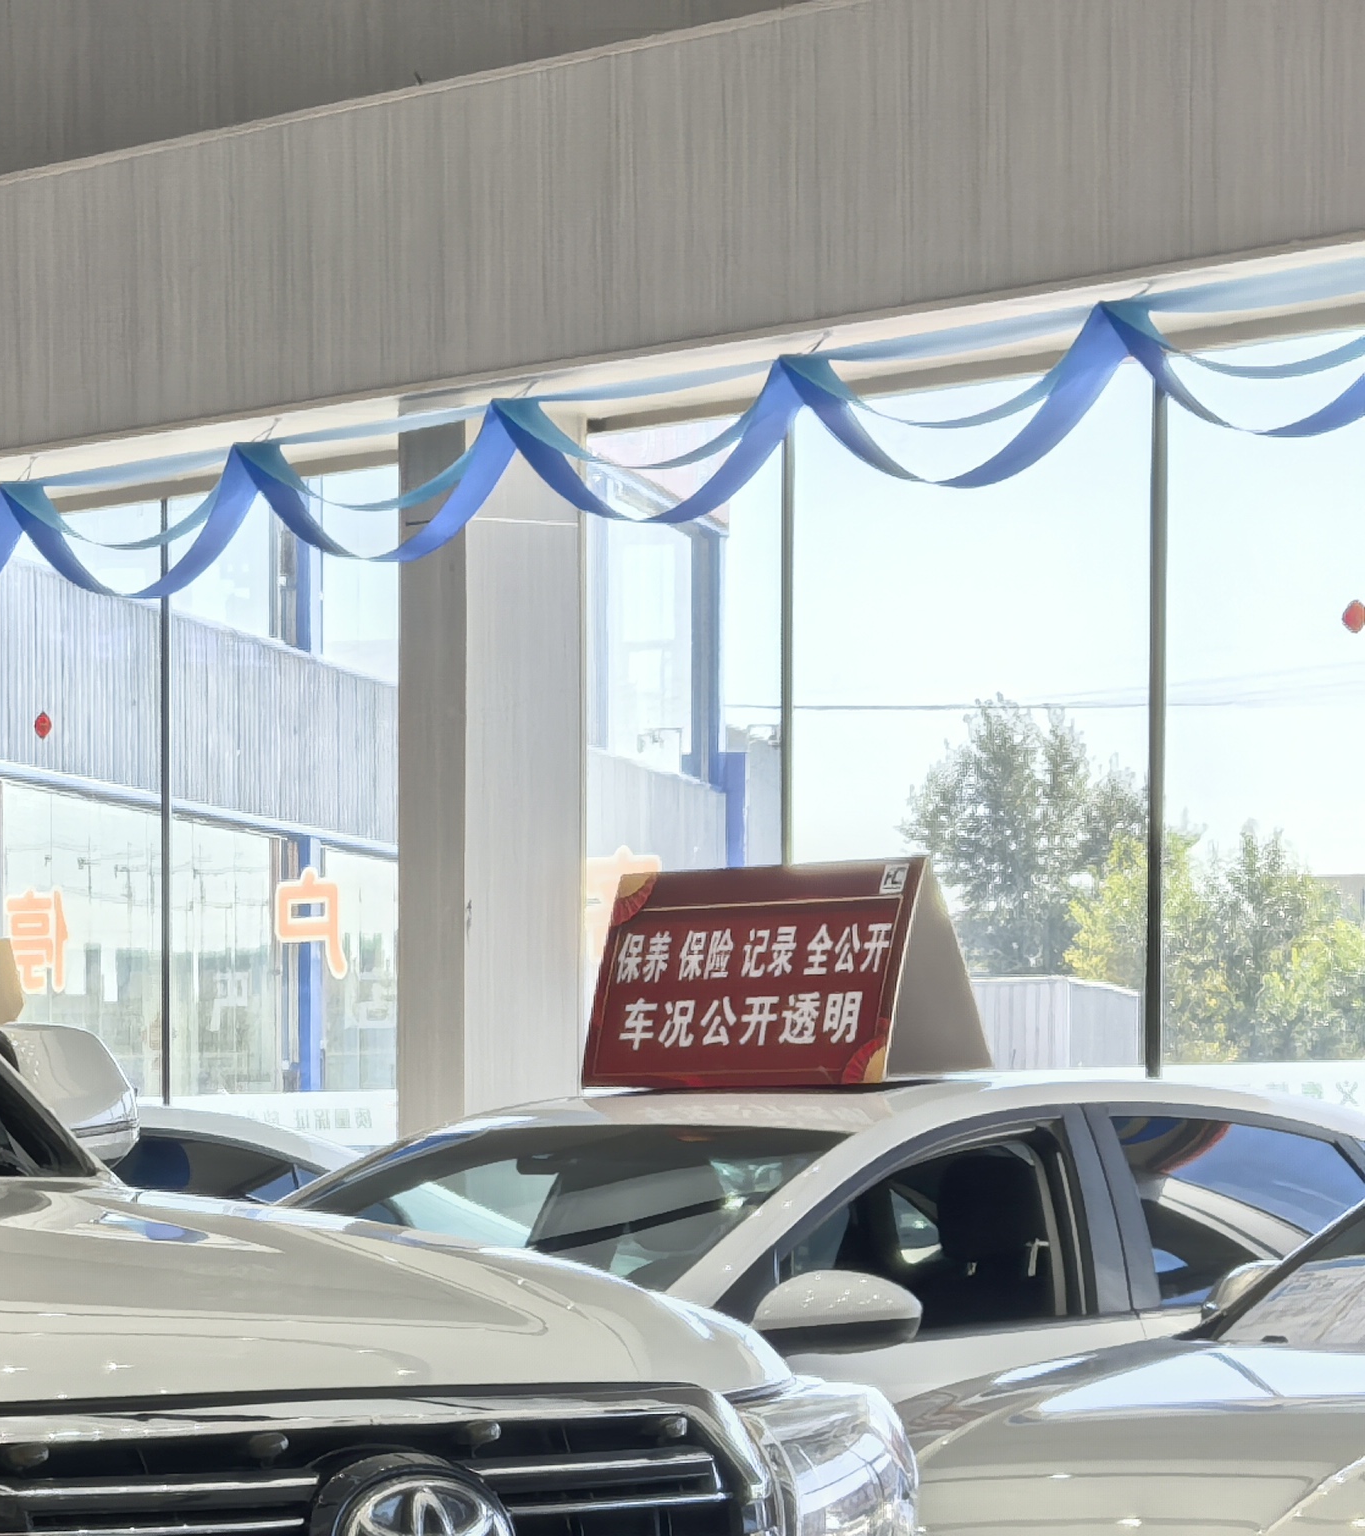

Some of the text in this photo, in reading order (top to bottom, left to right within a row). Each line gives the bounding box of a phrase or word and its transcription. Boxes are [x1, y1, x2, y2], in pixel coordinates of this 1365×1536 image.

[616, 922, 894, 984] 保养 保险 记录 全公开
[618, 990, 864, 1051] 车况公开透明
